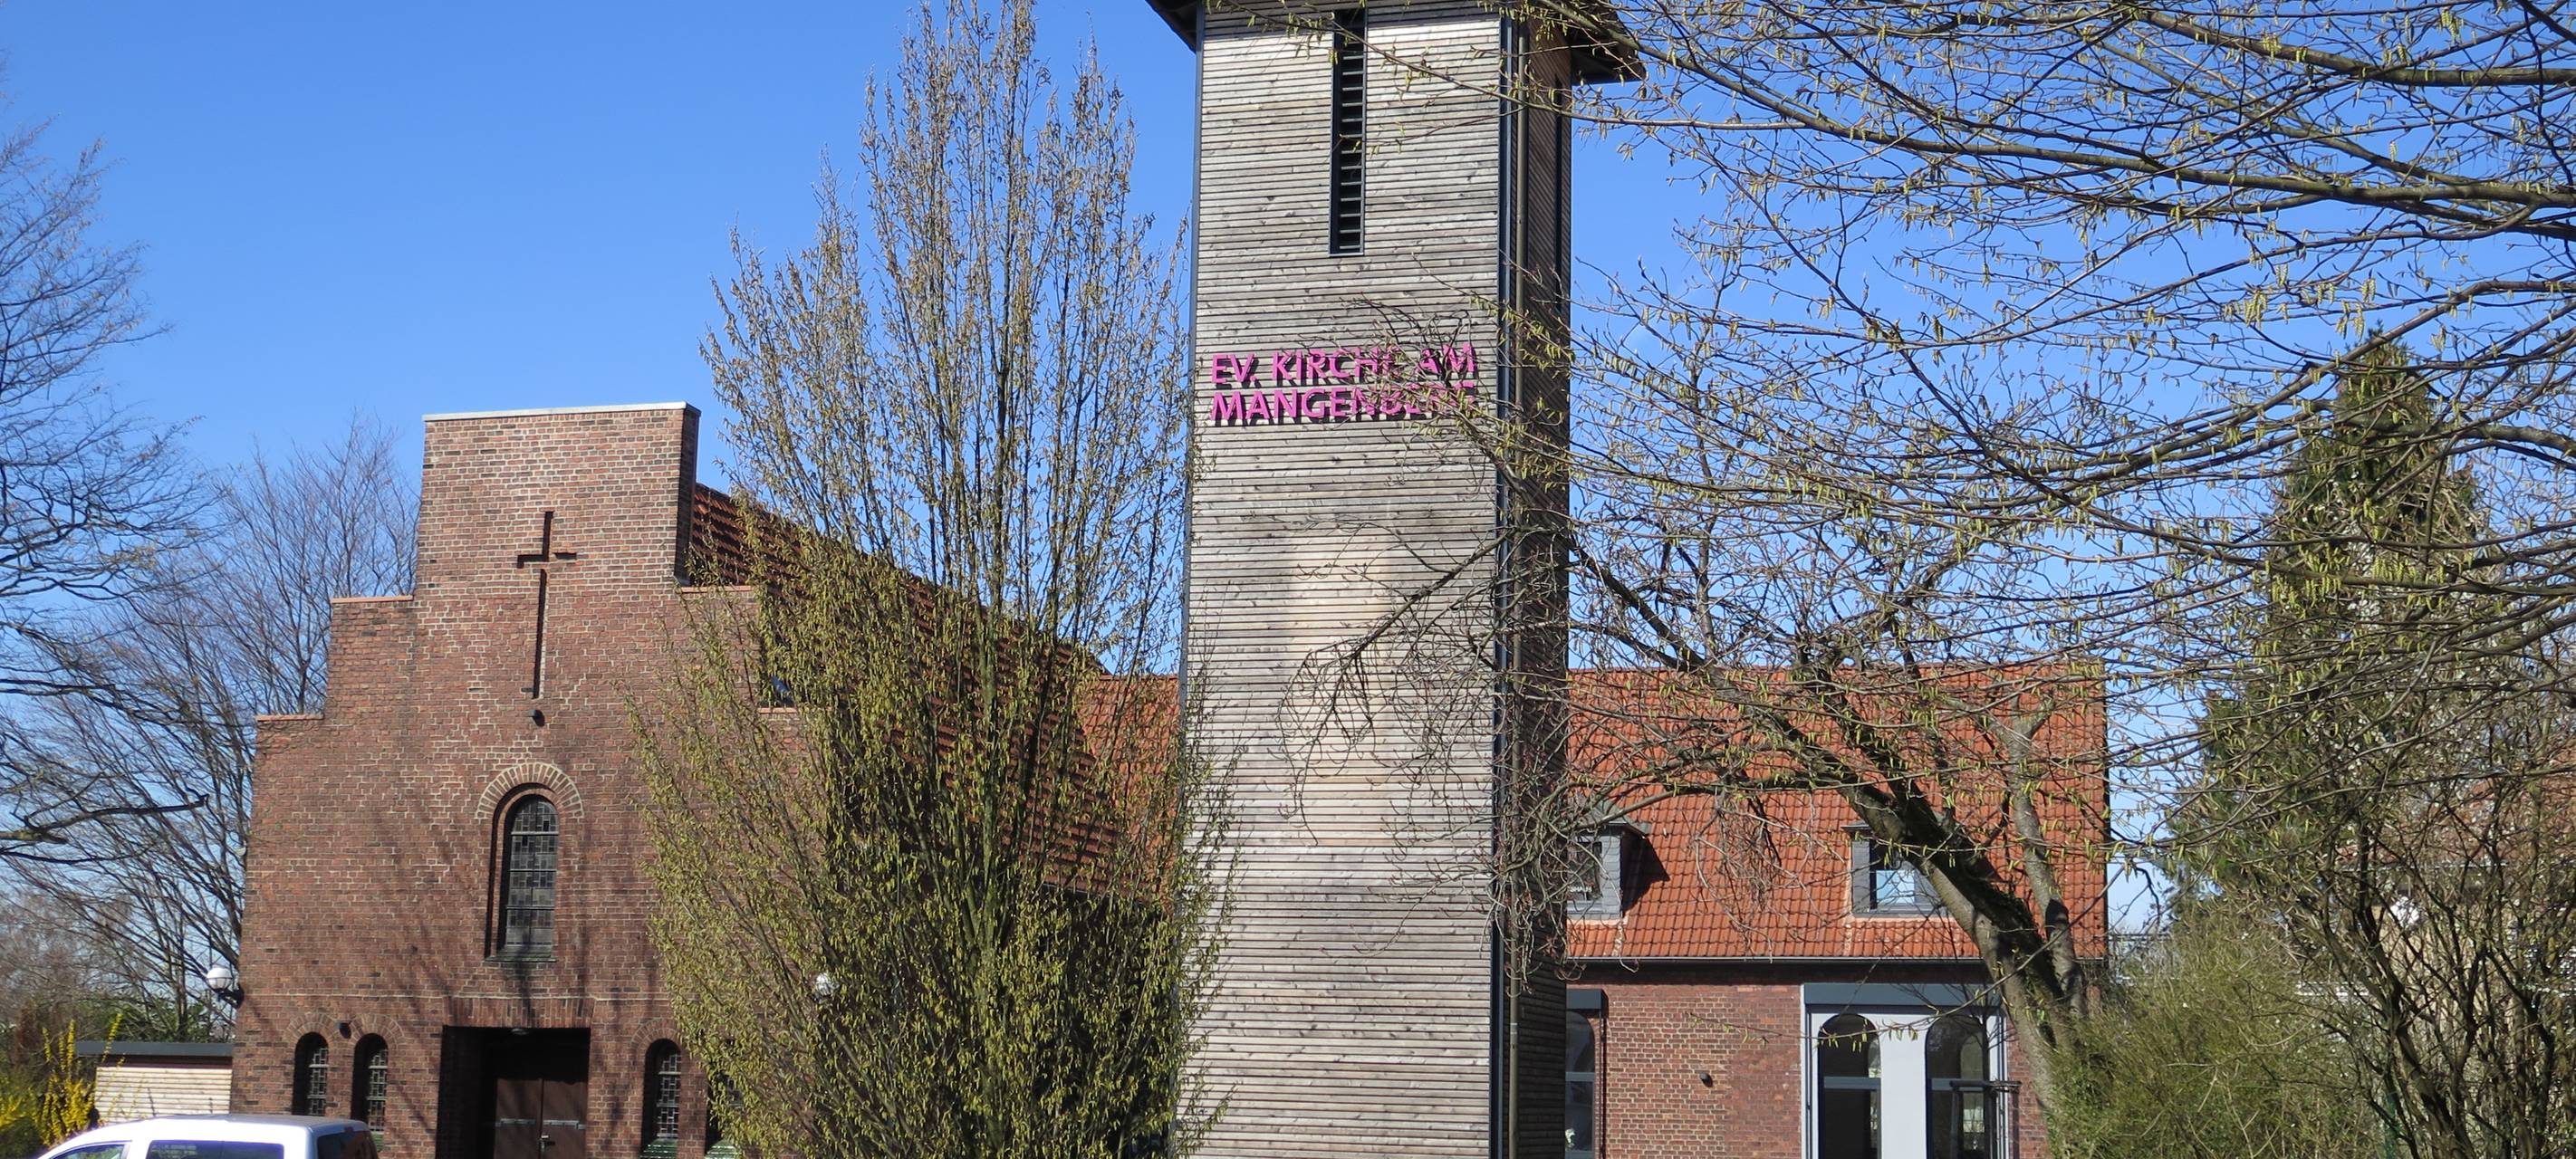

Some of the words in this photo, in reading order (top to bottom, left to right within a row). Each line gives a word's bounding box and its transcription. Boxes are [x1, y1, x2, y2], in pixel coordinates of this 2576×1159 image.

[1210, 352, 1258, 384] EV.
[1414, 341, 1475, 376] AM
[1210, 380, 1476, 420] MANGENB
